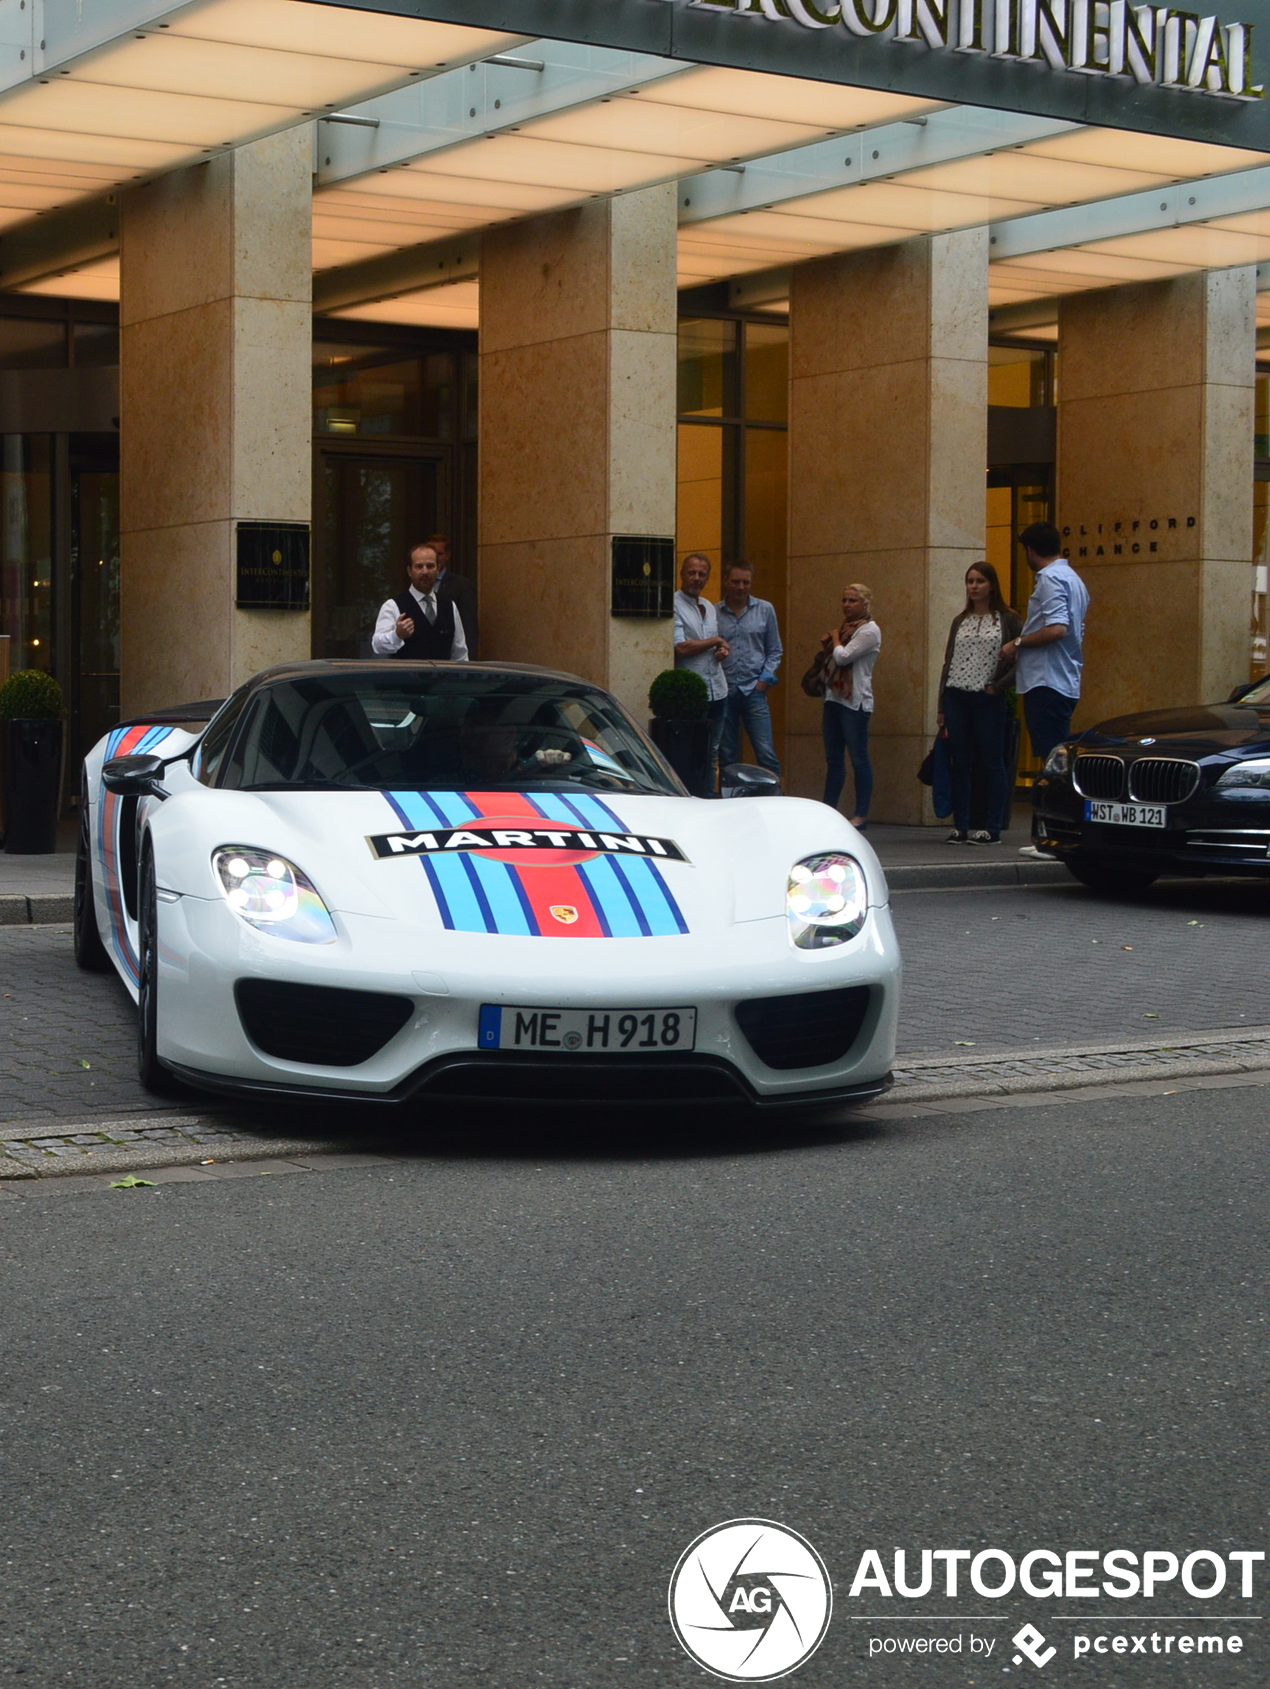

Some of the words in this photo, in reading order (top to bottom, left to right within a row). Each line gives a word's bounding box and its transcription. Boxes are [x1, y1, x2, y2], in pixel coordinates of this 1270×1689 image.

[687, 0, 1266, 100] ONTINENTAL
[1062, 516, 1196, 536] CLIFFORD
[1062, 542, 1158, 558] CHANCE
[1091, 803, 1114, 820] WST
[1121, 806, 1137, 823] WB
[1139, 808, 1163, 826] 121
[386, 830, 668, 856] MARTINI
[486, 1031, 494, 1040] D
[514, 1012, 562, 1046] ME
[586, 1014, 610, 1047] H
[618, 1013, 680, 1048] 918
